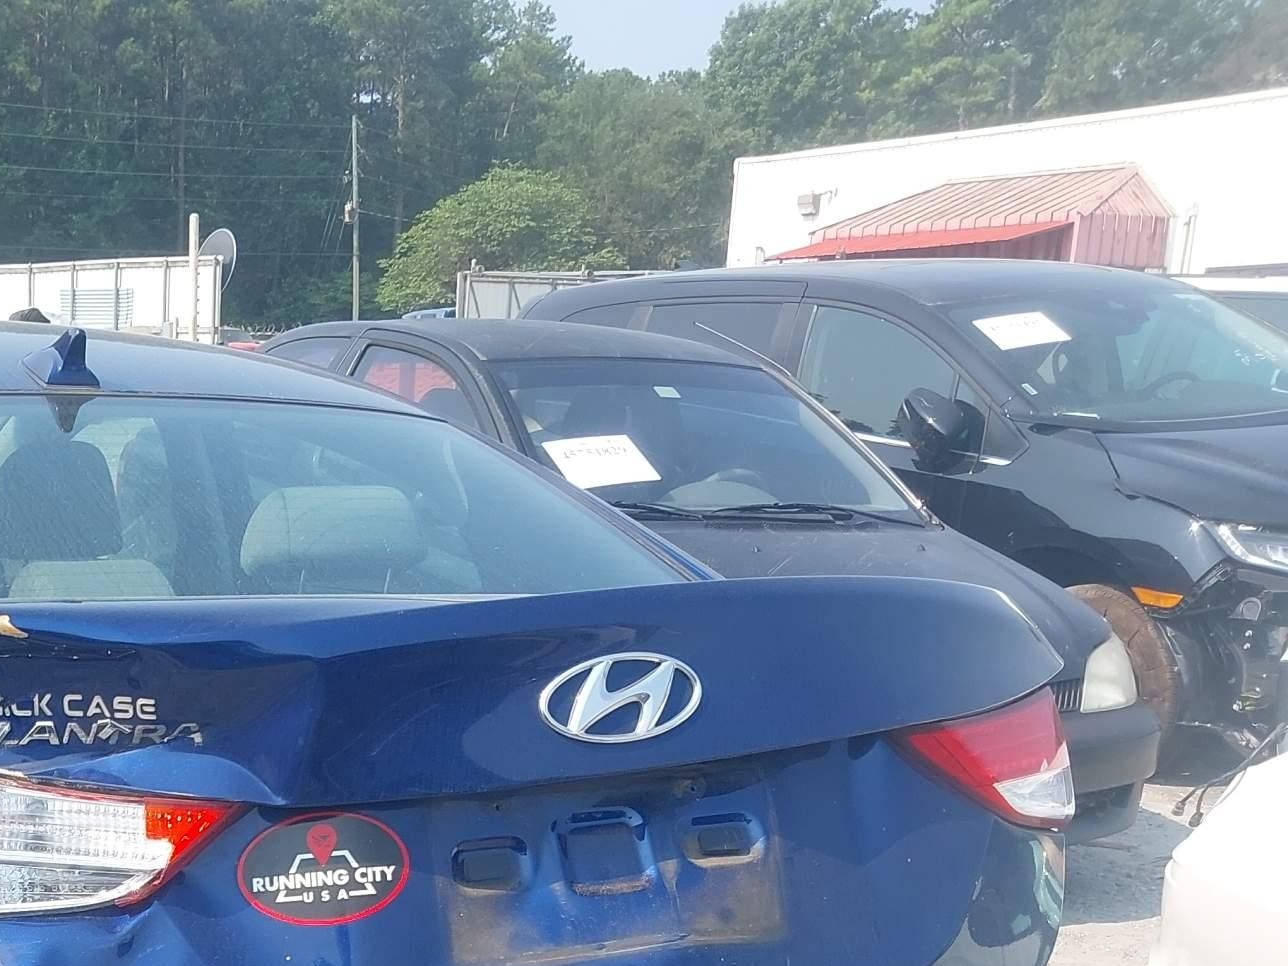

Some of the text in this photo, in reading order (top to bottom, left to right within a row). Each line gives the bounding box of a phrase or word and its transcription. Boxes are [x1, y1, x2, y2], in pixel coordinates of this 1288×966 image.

[62, 693, 157, 720] CASE
[252, 865, 397, 893] RUNNING CITY
